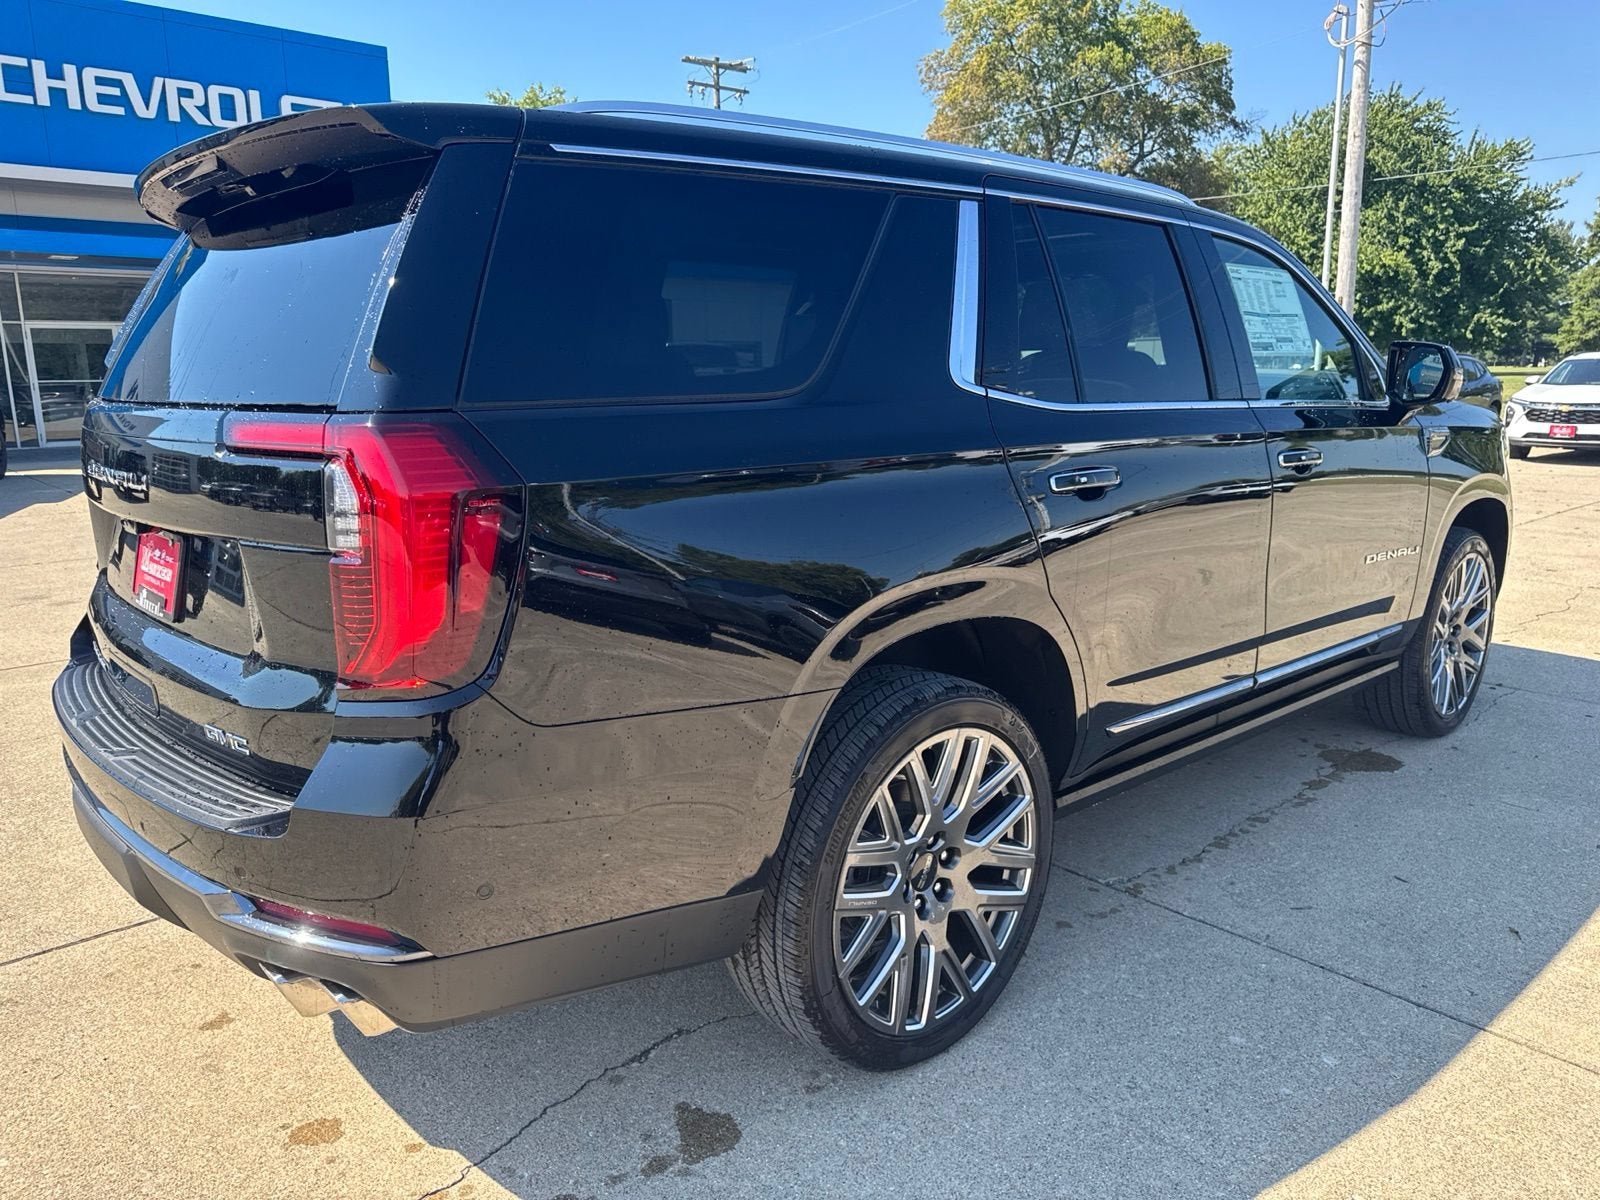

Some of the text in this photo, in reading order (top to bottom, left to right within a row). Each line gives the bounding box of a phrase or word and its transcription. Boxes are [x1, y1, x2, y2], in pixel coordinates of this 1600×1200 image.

[0, 55, 343, 127] CHEVROL
[468, 499, 501, 507] GMC
[1365, 546, 1420, 564] DENALI
[204, 724, 250, 755] GMC
